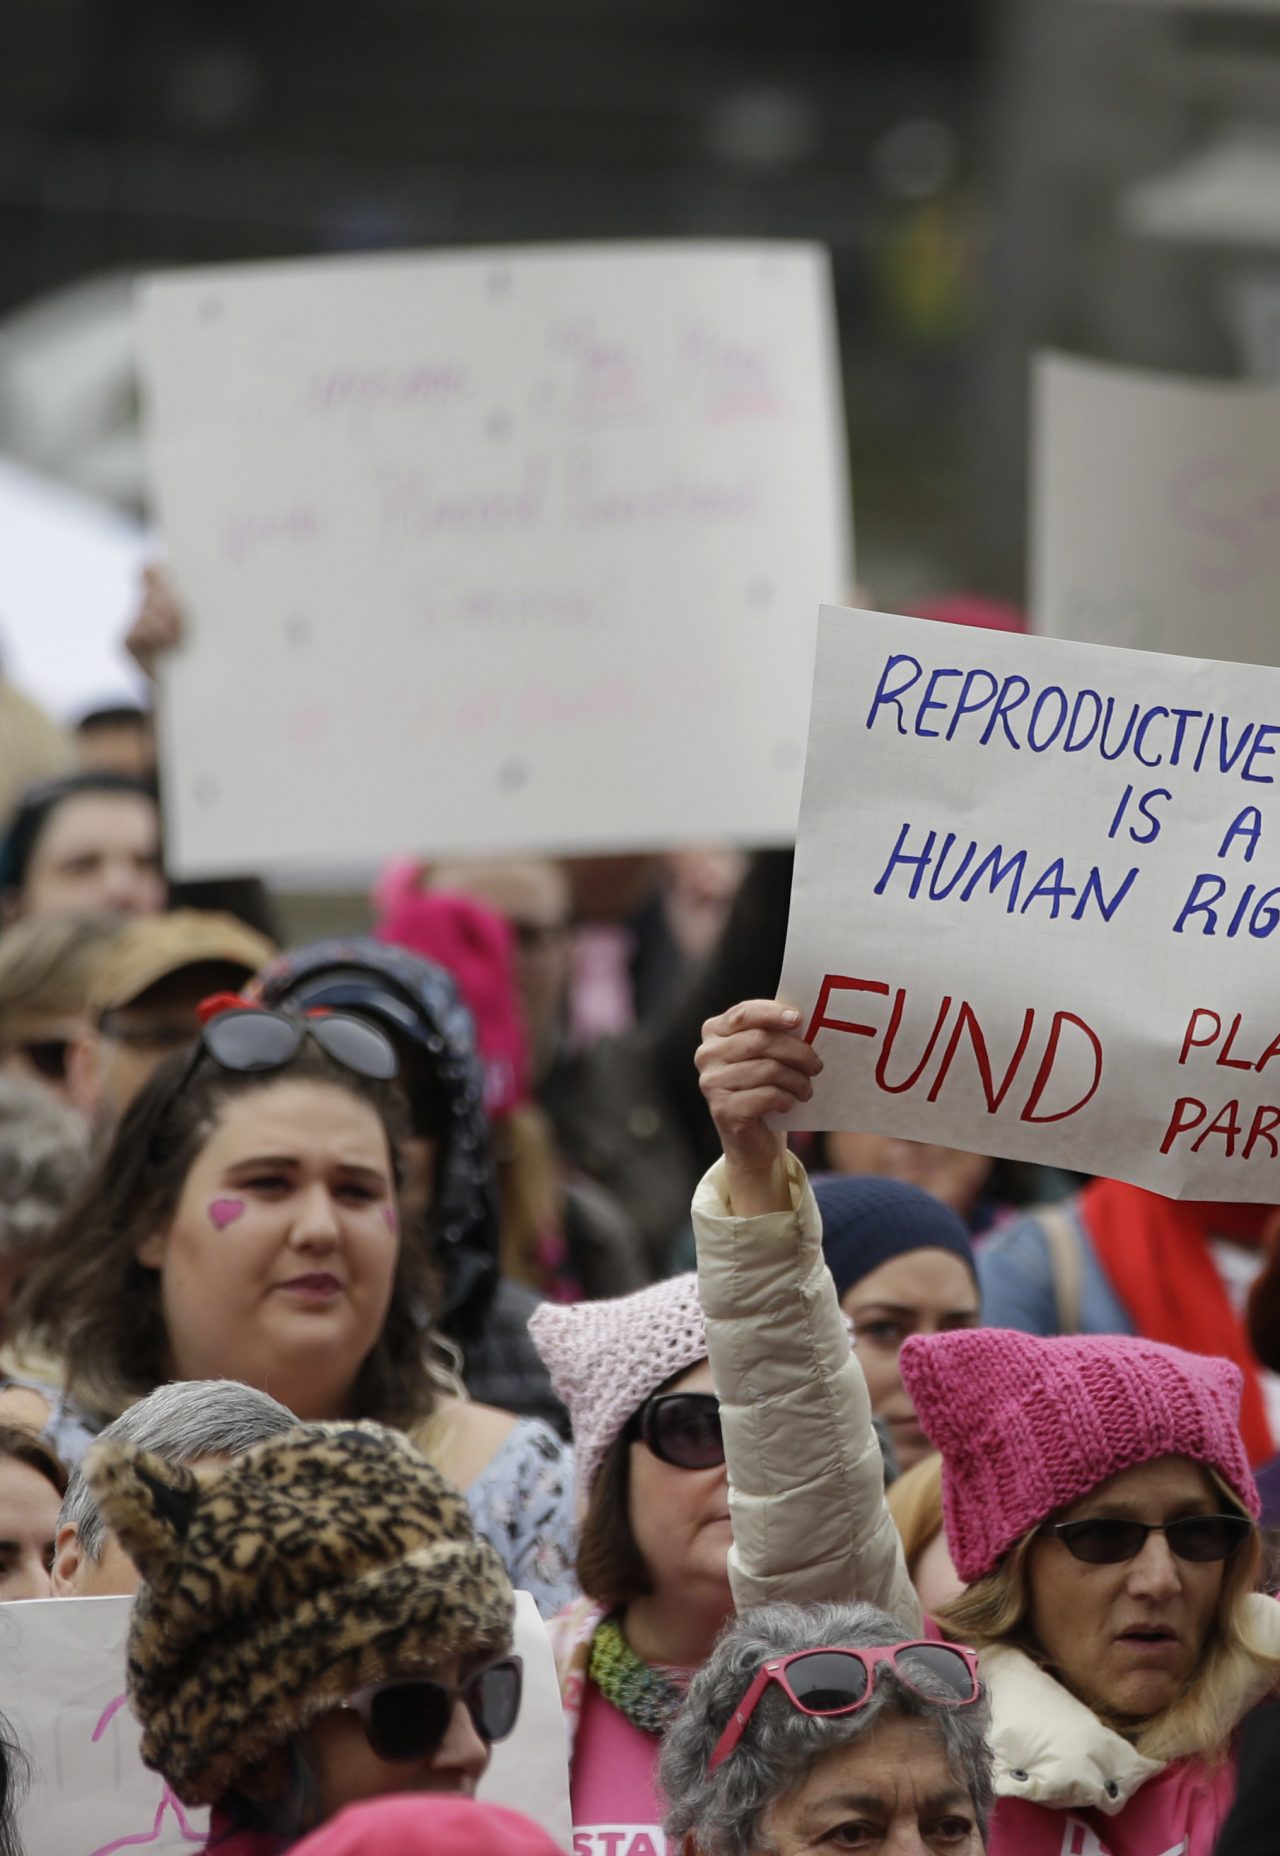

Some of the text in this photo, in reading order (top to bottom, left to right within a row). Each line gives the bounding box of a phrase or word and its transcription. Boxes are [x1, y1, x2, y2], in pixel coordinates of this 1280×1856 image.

[873, 822, 1140, 922] HUMAN
[1107, 784, 1263, 862] IS A
[803, 974, 1104, 1124] FUND
